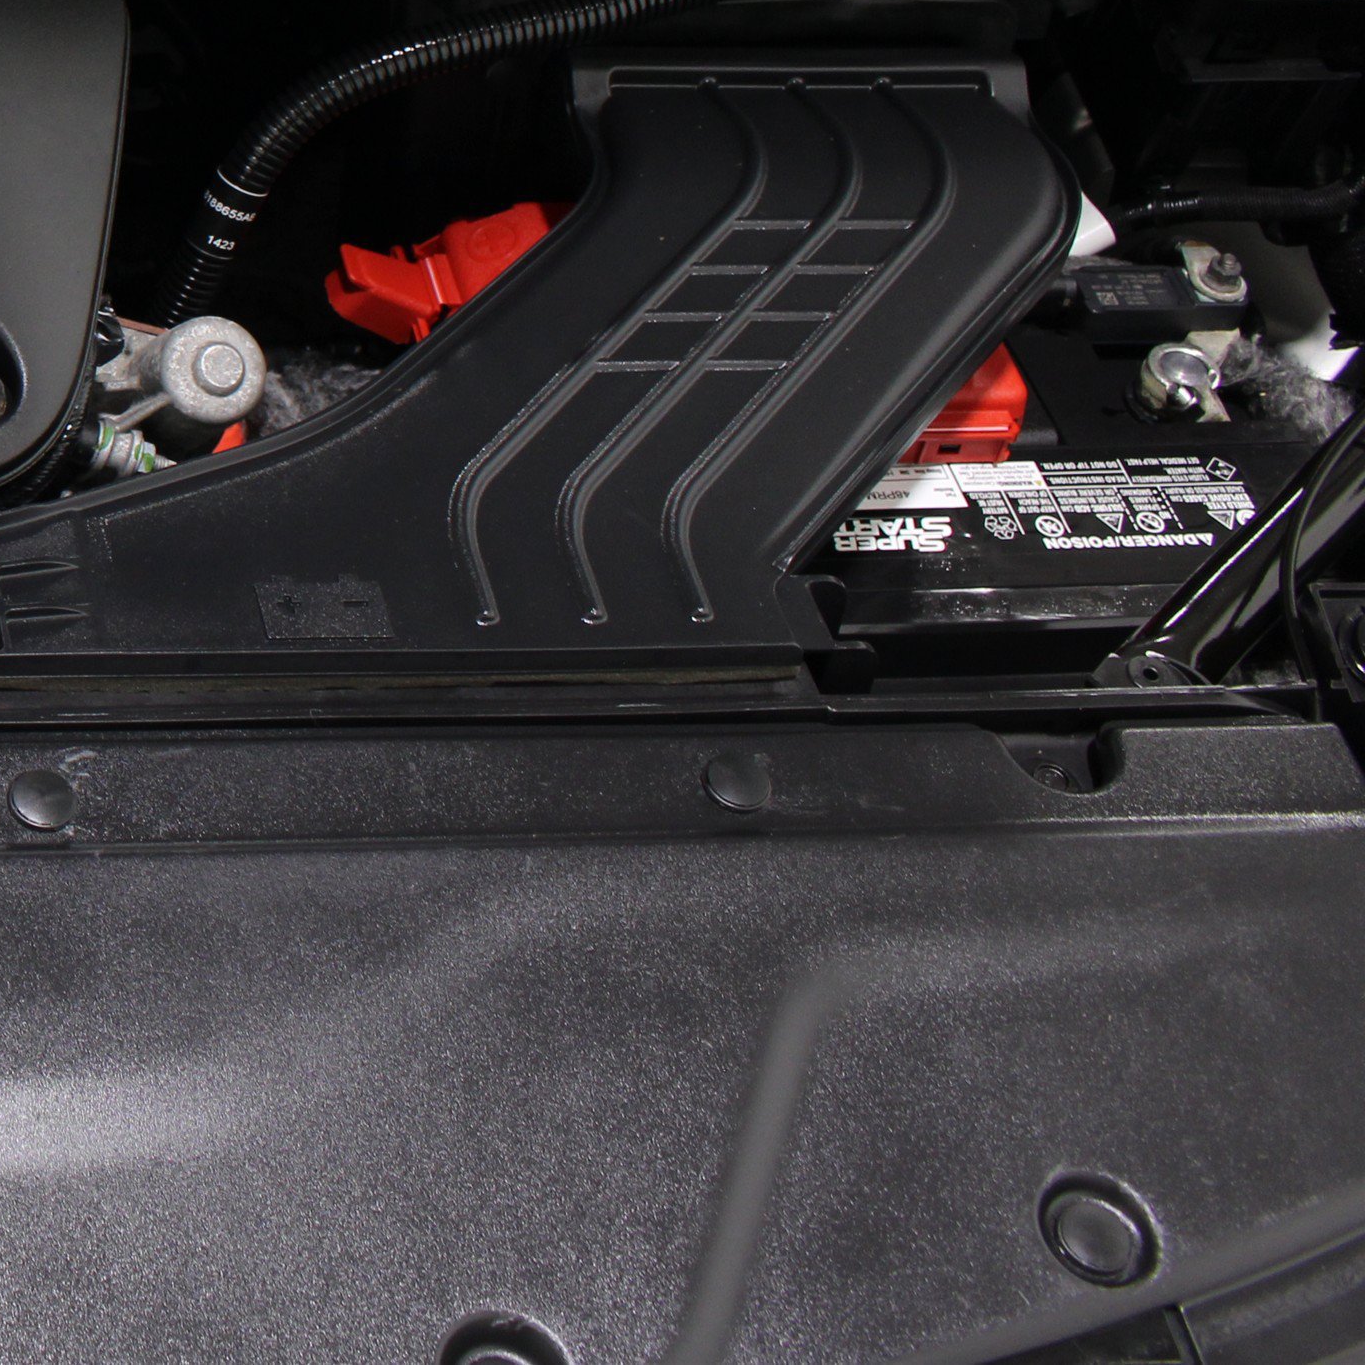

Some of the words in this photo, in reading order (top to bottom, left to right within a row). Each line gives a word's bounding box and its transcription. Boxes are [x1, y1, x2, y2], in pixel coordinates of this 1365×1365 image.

[207, 235, 236, 251] 1423
[833, 535, 946, 553] SUPER
[1042, 533, 1200, 549] DANGER/POISON
